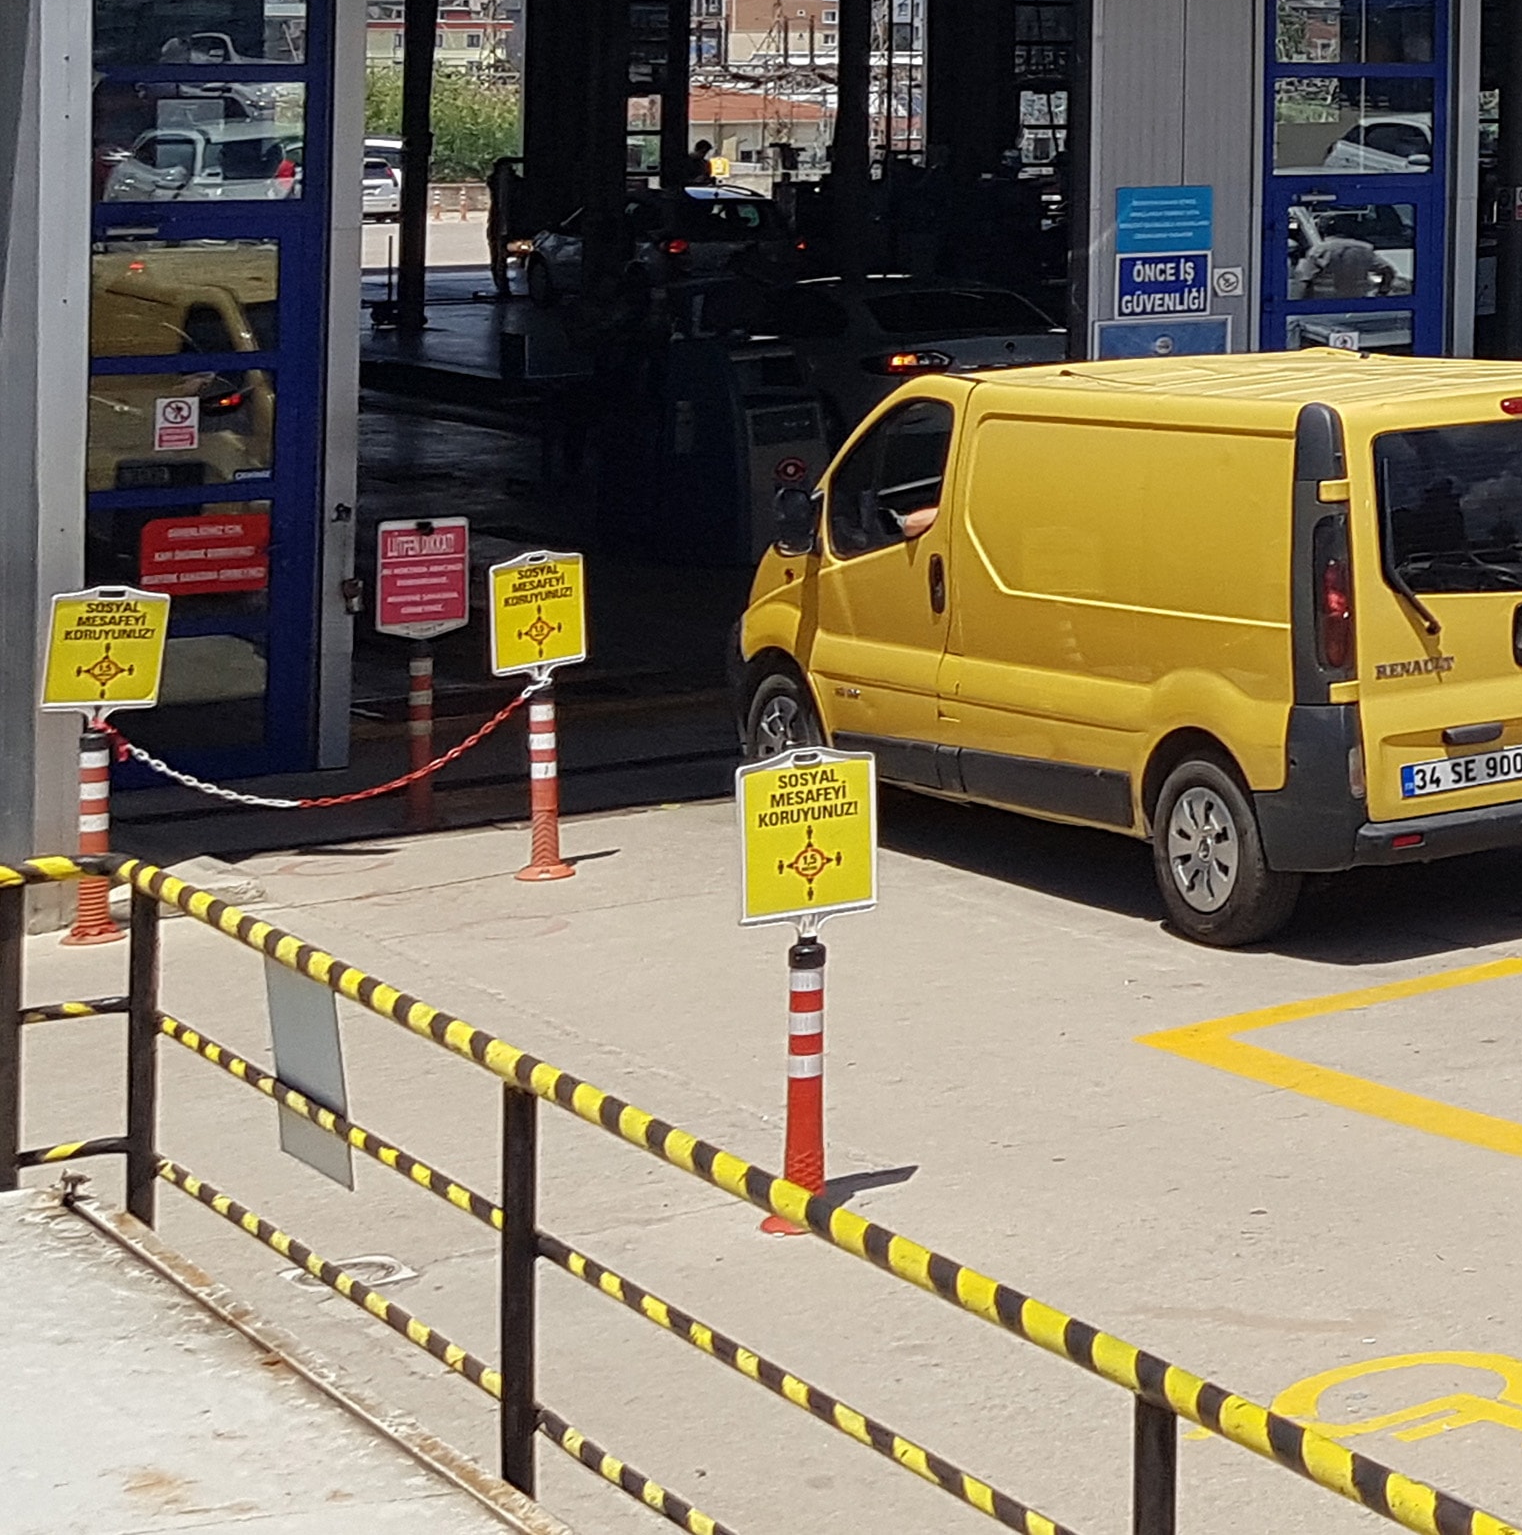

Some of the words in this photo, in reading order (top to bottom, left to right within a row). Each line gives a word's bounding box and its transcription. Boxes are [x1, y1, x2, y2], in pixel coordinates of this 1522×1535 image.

[1132, 260, 1176, 283] ÖNCE
[1180, 257, 1195, 285] İŞ
[1121, 286, 1205, 314] GÜVENLİĞİ
[517, 564, 559, 580] SOSYAL
[77, 613, 147, 626] MESAFEYİ
[86, 601, 141, 613] SOSYAL
[64, 628, 156, 641] KORUYUNUZ!
[1374, 656, 1455, 681] RENAULT
[778, 768, 839, 790] SOSYAL
[1414, 765, 1442, 791] 34
[1451, 758, 1477, 785] SE
[770, 780, 847, 809] MESAFEYİ
[757, 800, 859, 829] KORUYUNUZ!
